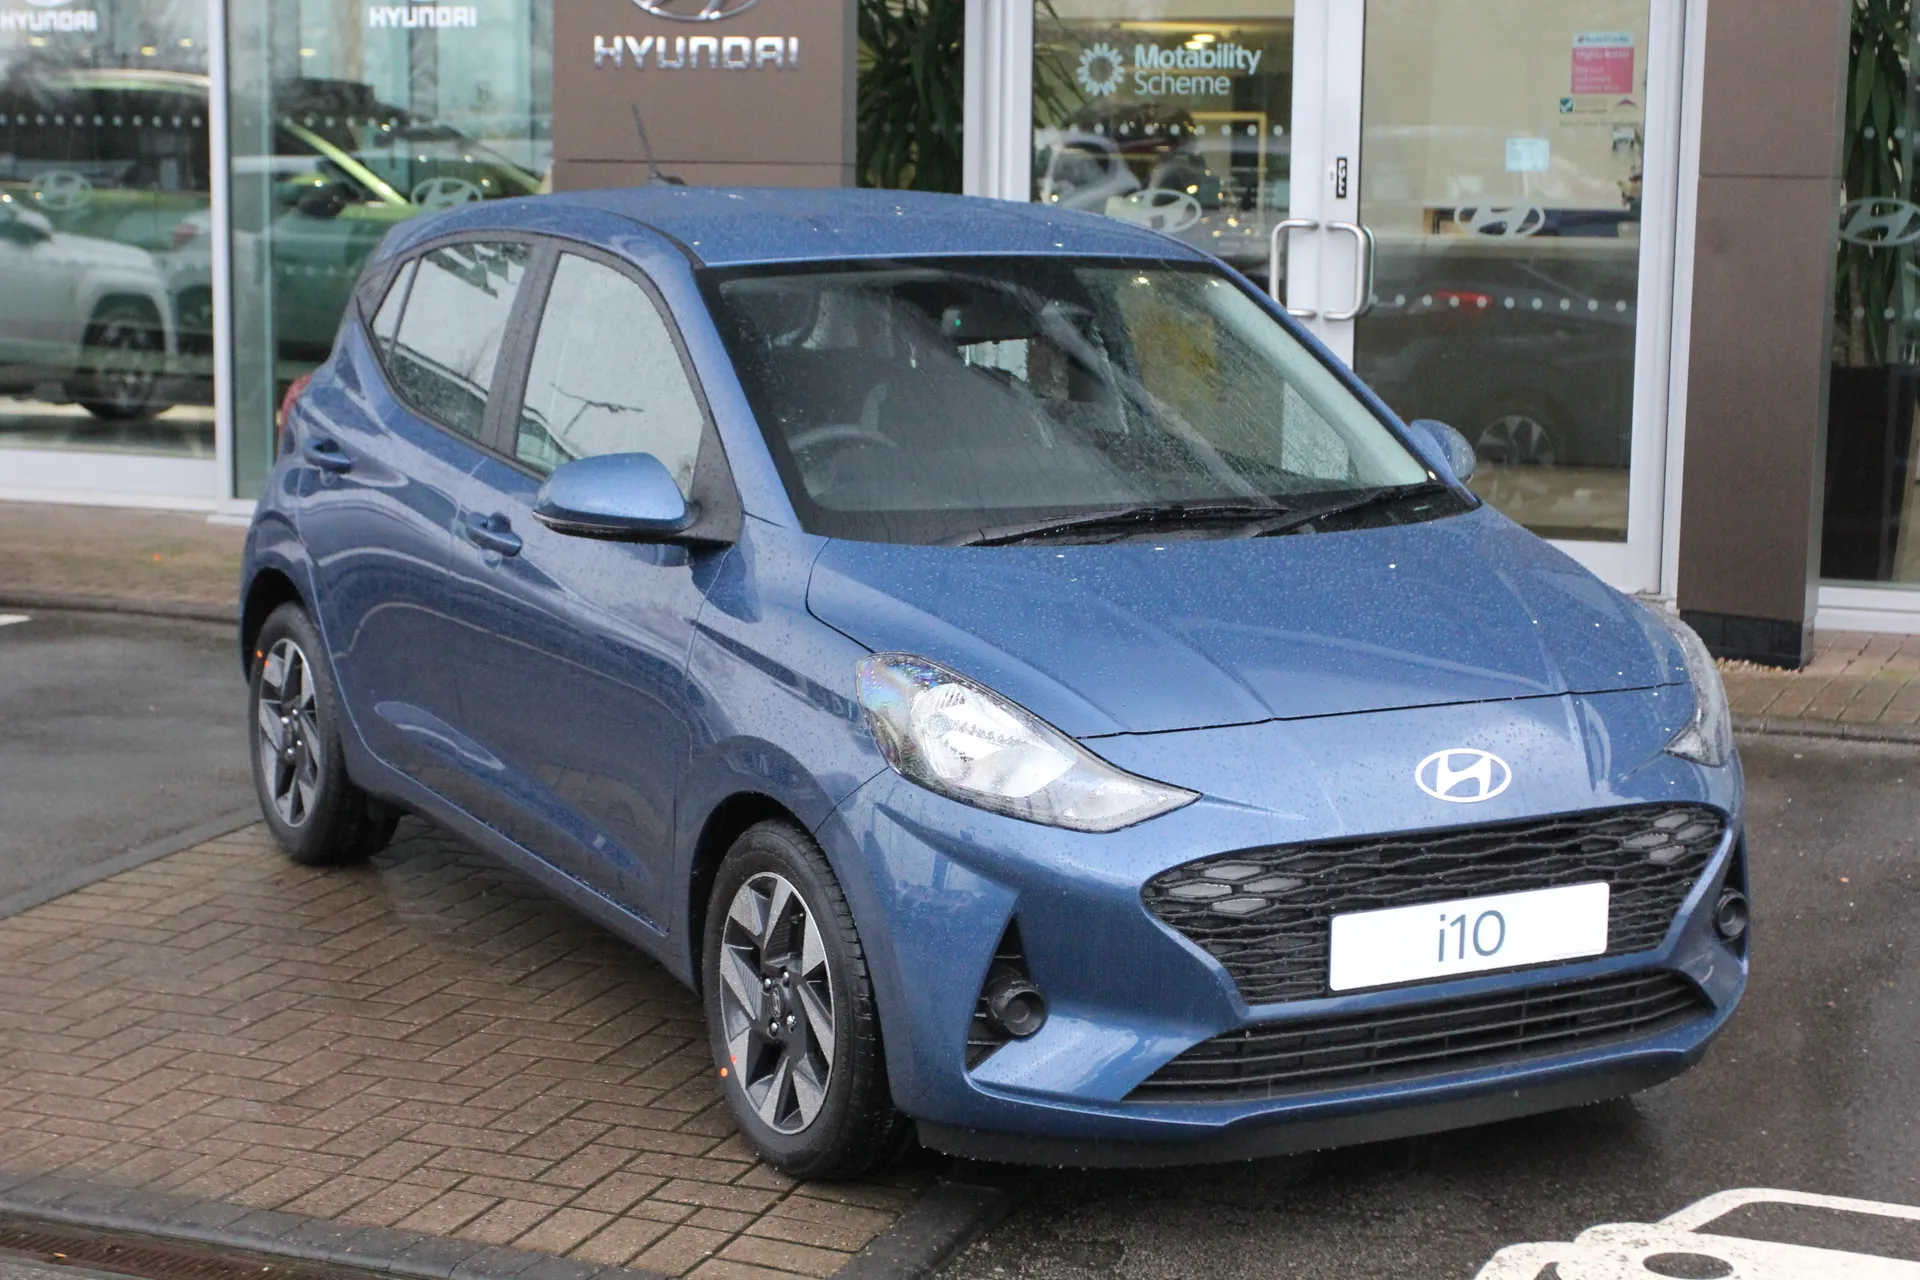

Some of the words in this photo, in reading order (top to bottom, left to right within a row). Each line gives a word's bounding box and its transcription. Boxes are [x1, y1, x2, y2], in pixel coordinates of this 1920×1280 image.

[0, 10, 98, 32] HYUNDAI
[369, 6, 477, 28] HYUNDAI
[593, 35, 799, 69] HYUNDAI
[1134, 43, 1262, 75] Motability
[1134, 71, 1231, 96] Scheme
[1438, 909, 1506, 962] i10
